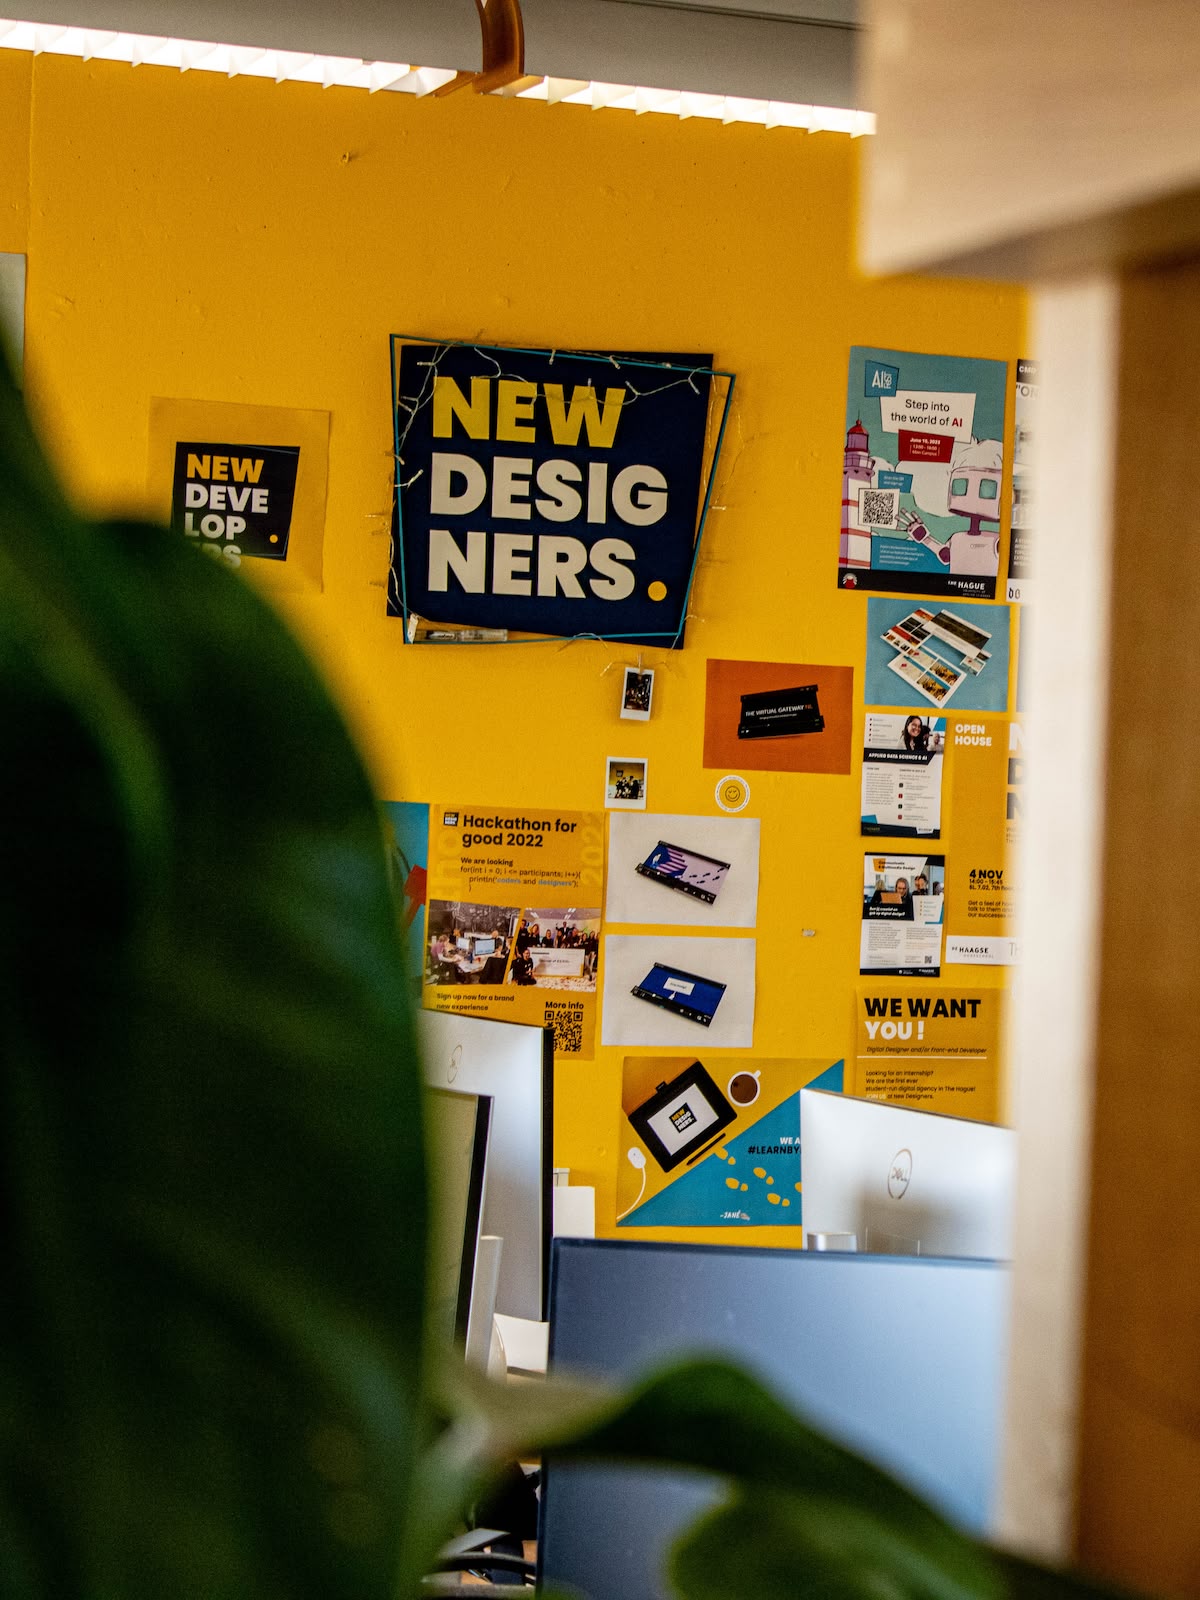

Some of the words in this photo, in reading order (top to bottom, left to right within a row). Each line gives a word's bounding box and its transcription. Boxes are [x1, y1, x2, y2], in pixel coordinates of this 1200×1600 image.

[432, 376, 627, 448] NEW
[905, 399, 929, 412] Step
[931, 401, 950, 412] into
[891, 412, 907, 422] the
[909, 415, 937, 425] world
[939, 416, 950, 426] of
[952, 418, 963, 427] AI
[186, 453, 264, 484] NEW
[430, 452, 668, 526] DESIG
[185, 482, 269, 514] DEVE
[184, 512, 246, 541] LOP
[958, 581, 986, 590] HAGUE
[778, 704, 804, 713] GATEWAY
[956, 724, 985, 734] OPEN
[955, 735, 992, 746] HOUSE
[463, 815, 551, 831] Hackathon
[555, 818, 577, 832] for
[462, 833, 503, 848] good
[506, 834, 544, 848] 2022
[487, 858, 514, 867] looking
[519, 870, 564, 878] participants;
[970, 869, 976, 878] 4
[979, 870, 1003, 879] NOV
[568, 1002, 584, 1010] info
[864, 998, 902, 1017] WE
[908, 998, 981, 1018] WANT
[865, 1021, 913, 1040] YOU
[918, 1021, 924, 1040] !
[672, 1108, 685, 1121] NEW
[748, 1145, 801, 1154] #LEARNBY
